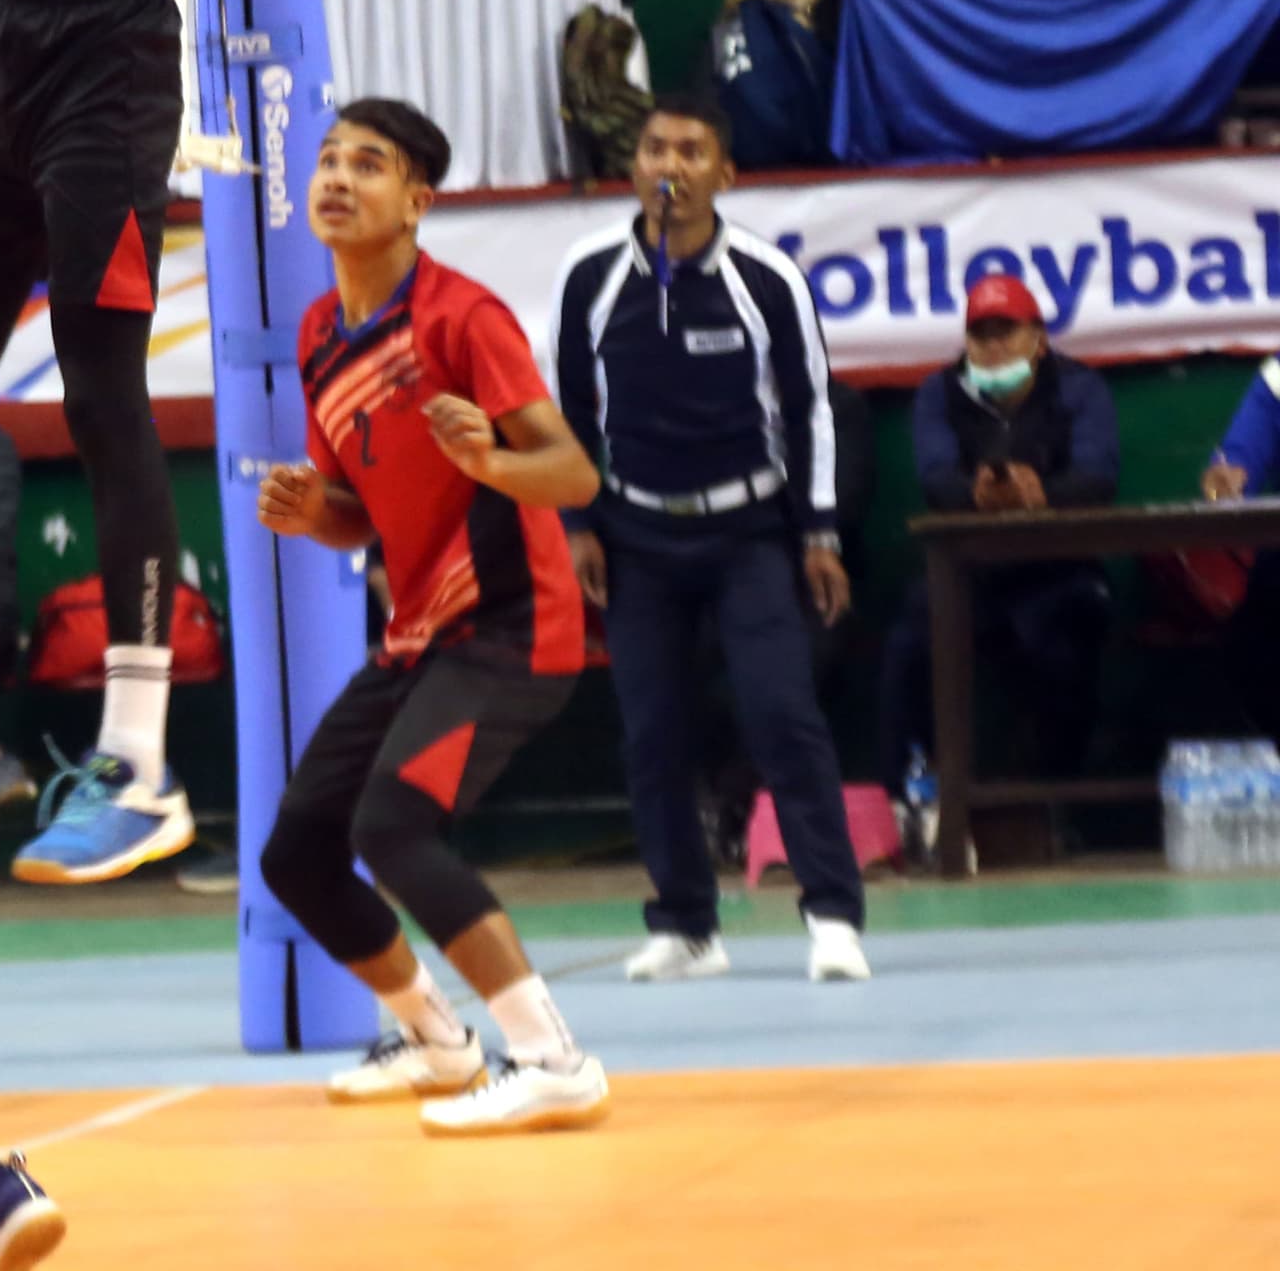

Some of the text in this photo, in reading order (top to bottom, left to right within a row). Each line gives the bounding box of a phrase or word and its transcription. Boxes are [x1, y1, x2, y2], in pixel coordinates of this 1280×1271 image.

[261, 103, 296, 230] Senoh
[778, 210, 1280, 336] olleybal
[353, 409, 378, 468] 2
